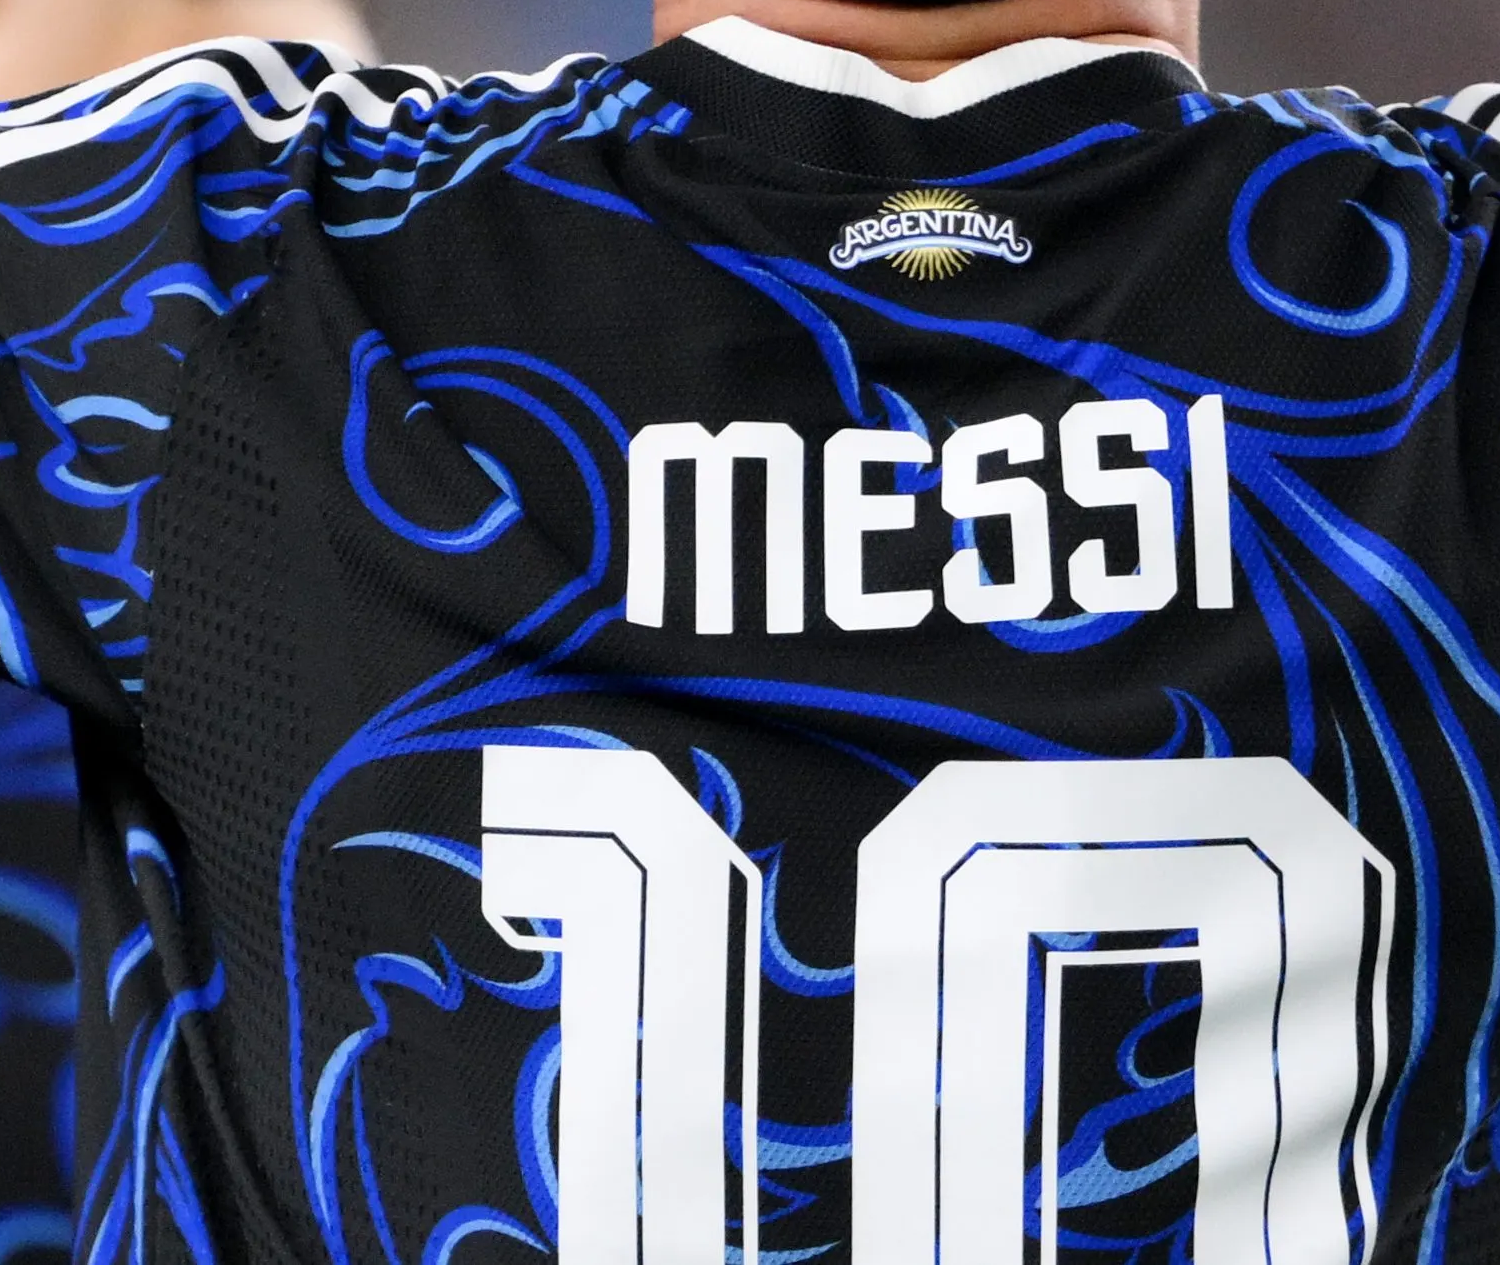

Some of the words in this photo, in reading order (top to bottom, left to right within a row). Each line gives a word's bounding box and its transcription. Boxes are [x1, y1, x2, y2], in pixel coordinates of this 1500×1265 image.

[837, 209, 1025, 259] ARGENTINA
[626, 394, 1234, 635] MESSI
[481, 744, 1397, 1265] 10
